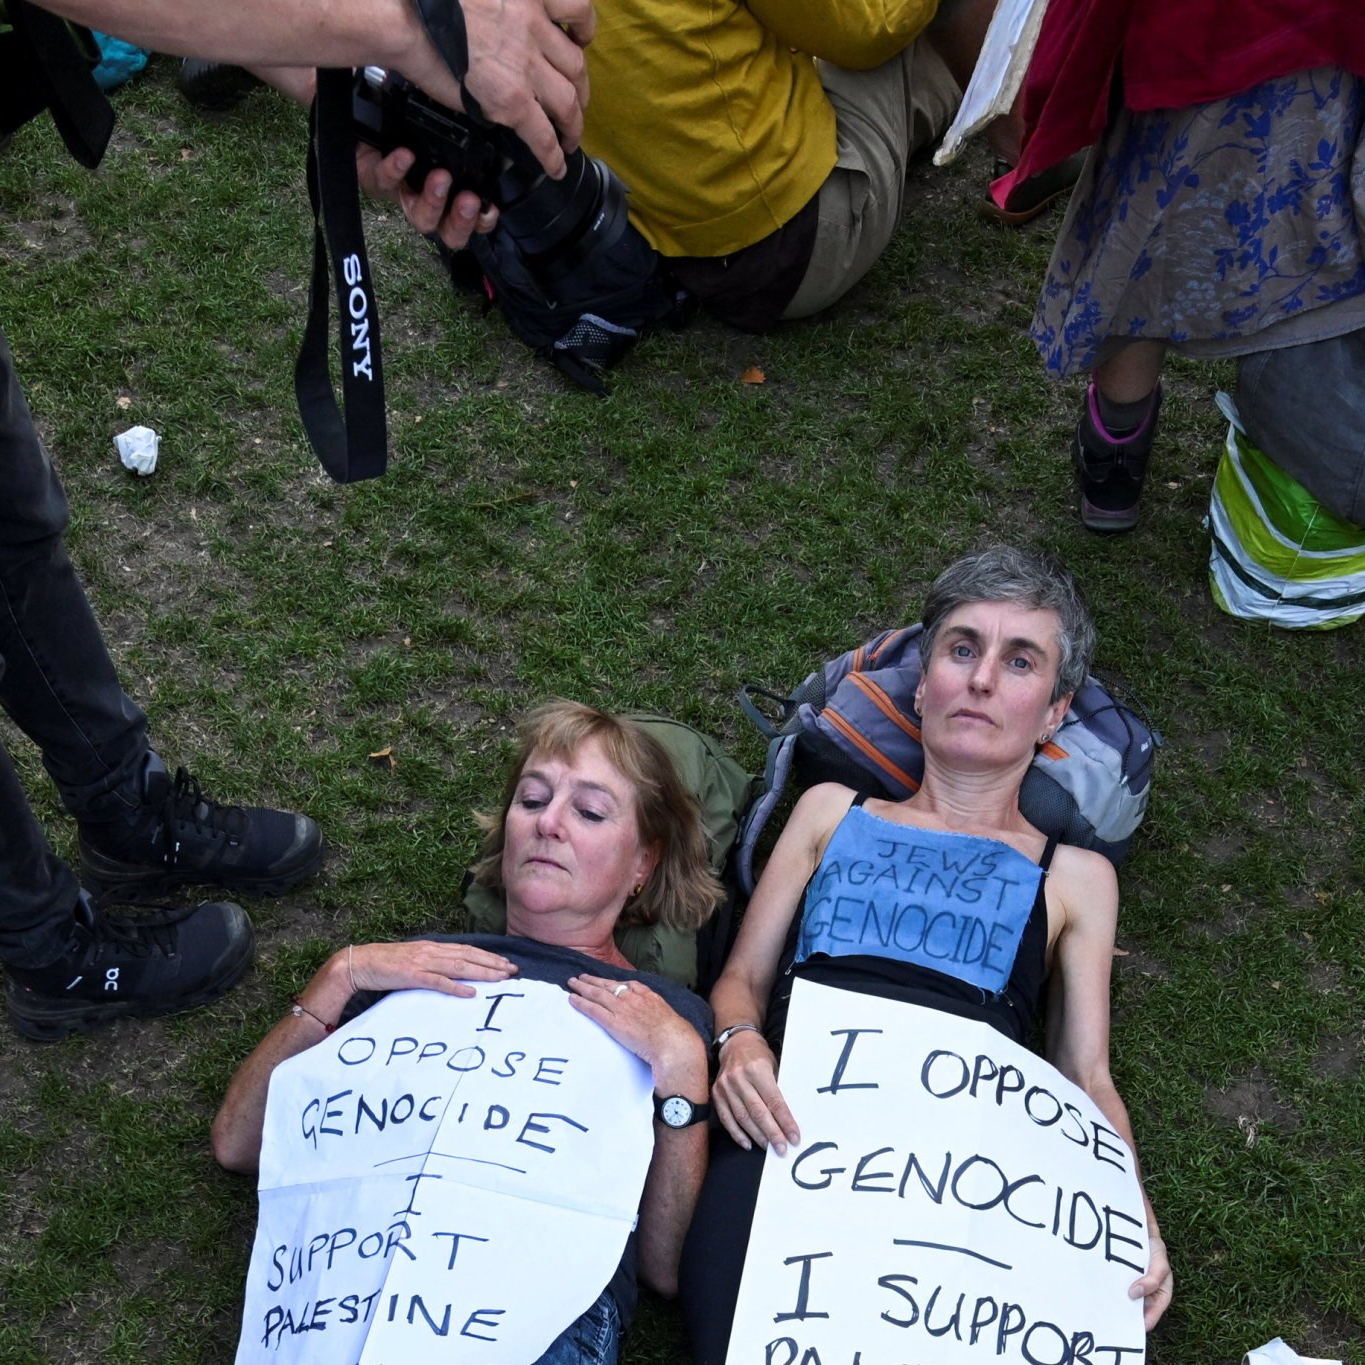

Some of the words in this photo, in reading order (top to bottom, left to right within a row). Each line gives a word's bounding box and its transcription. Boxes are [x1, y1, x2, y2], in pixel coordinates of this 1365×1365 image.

[343, 254, 372, 381] SONY
[818, 860, 1020, 911] AGAINST
[876, 839, 1004, 876] JEWS
[802, 895, 1015, 974] GENOCIDE
[476, 993, 524, 1032] I
[338, 1036, 569, 1086] OPPOSE
[302, 1089, 589, 1154] GENOCIDE
[817, 1029, 883, 1094] I
[920, 1049, 1126, 1173] OPPOSE
[393, 1173, 443, 1217] I
[791, 1141, 1145, 1273] GENOCIDE
[267, 1222, 490, 1293] SUPPORT
[774, 1252, 833, 1323] I
[261, 1293, 507, 1351] PALESTINE
